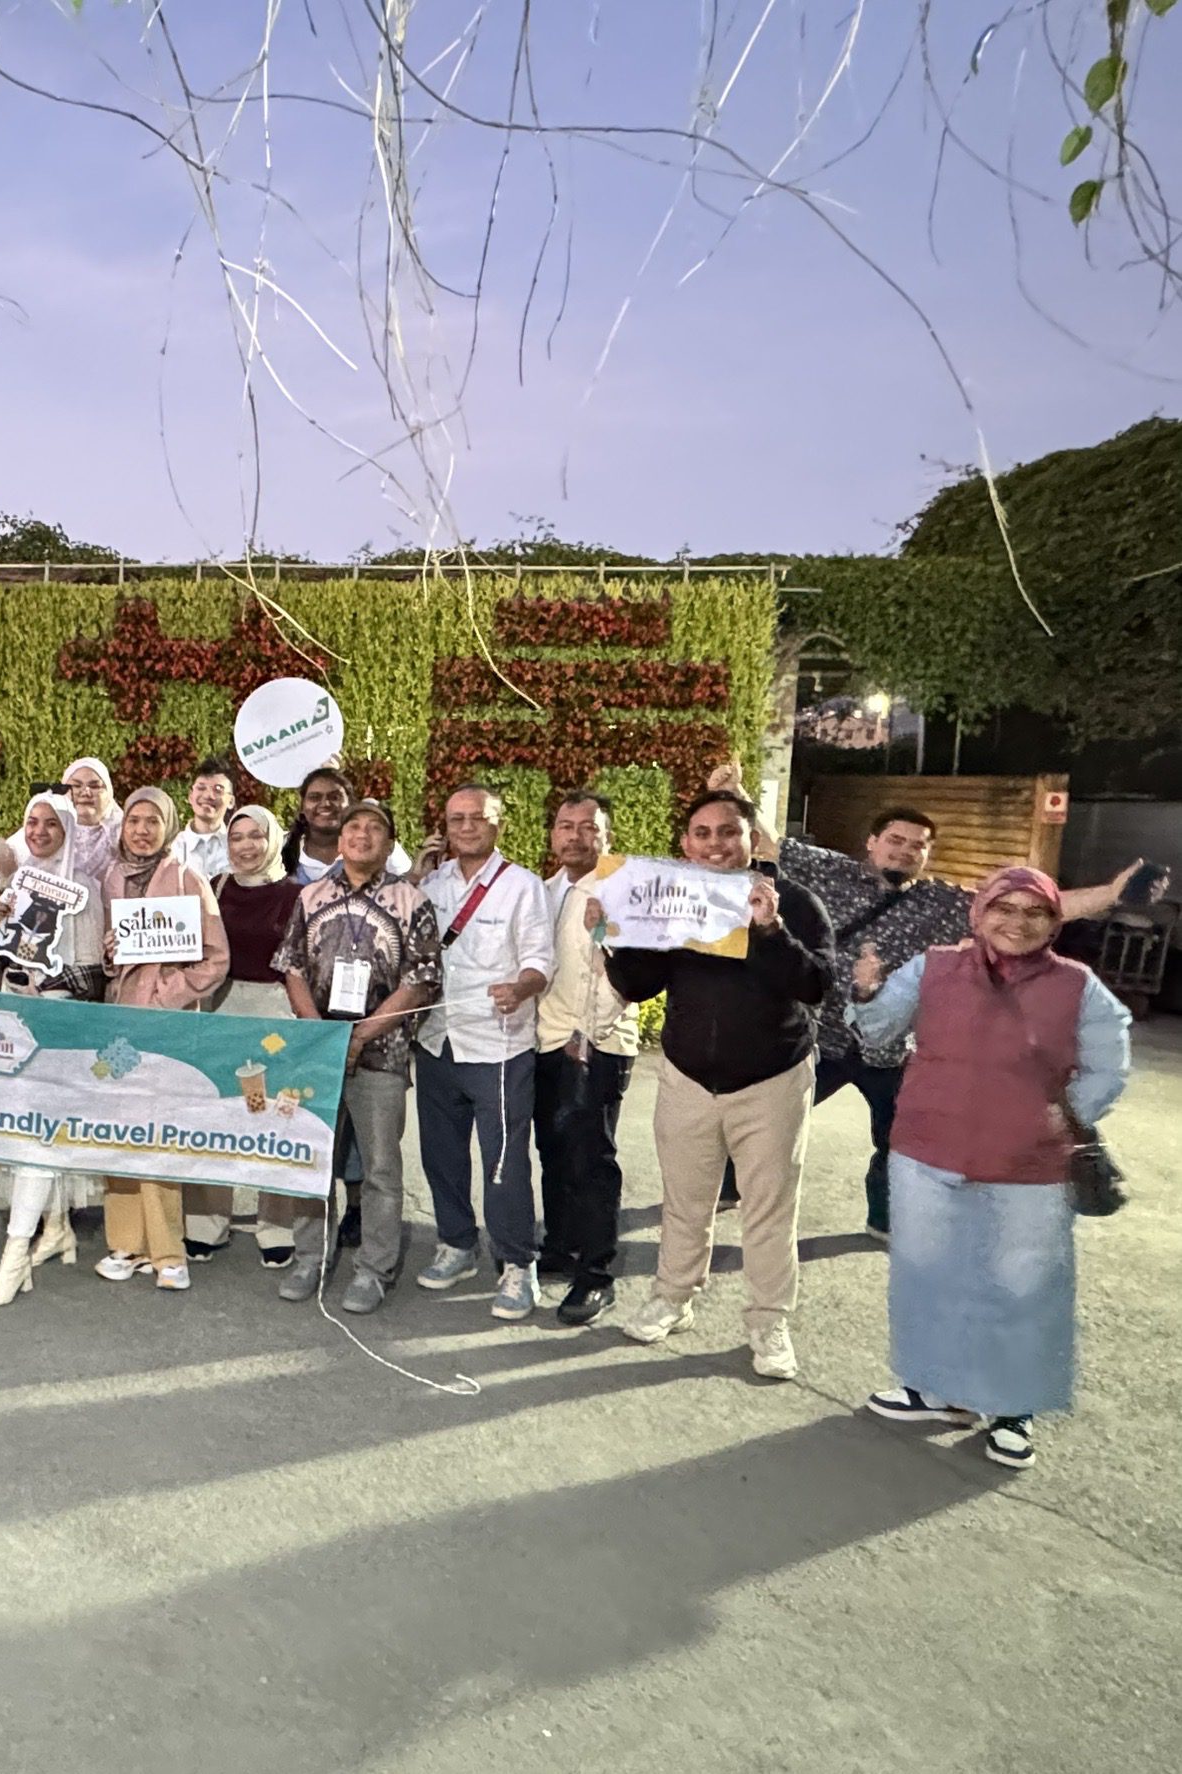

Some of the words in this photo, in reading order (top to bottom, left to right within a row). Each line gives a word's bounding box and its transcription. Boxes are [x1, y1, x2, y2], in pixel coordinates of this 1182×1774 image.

[242, 735, 278, 757] EVA
[278, 719, 309, 740] AIR
[119, 907, 172, 938] Salam
[133, 931, 196, 948] Taiwan
[67, 1117, 154, 1144] Travel
[162, 1124, 312, 1161] Promotion
